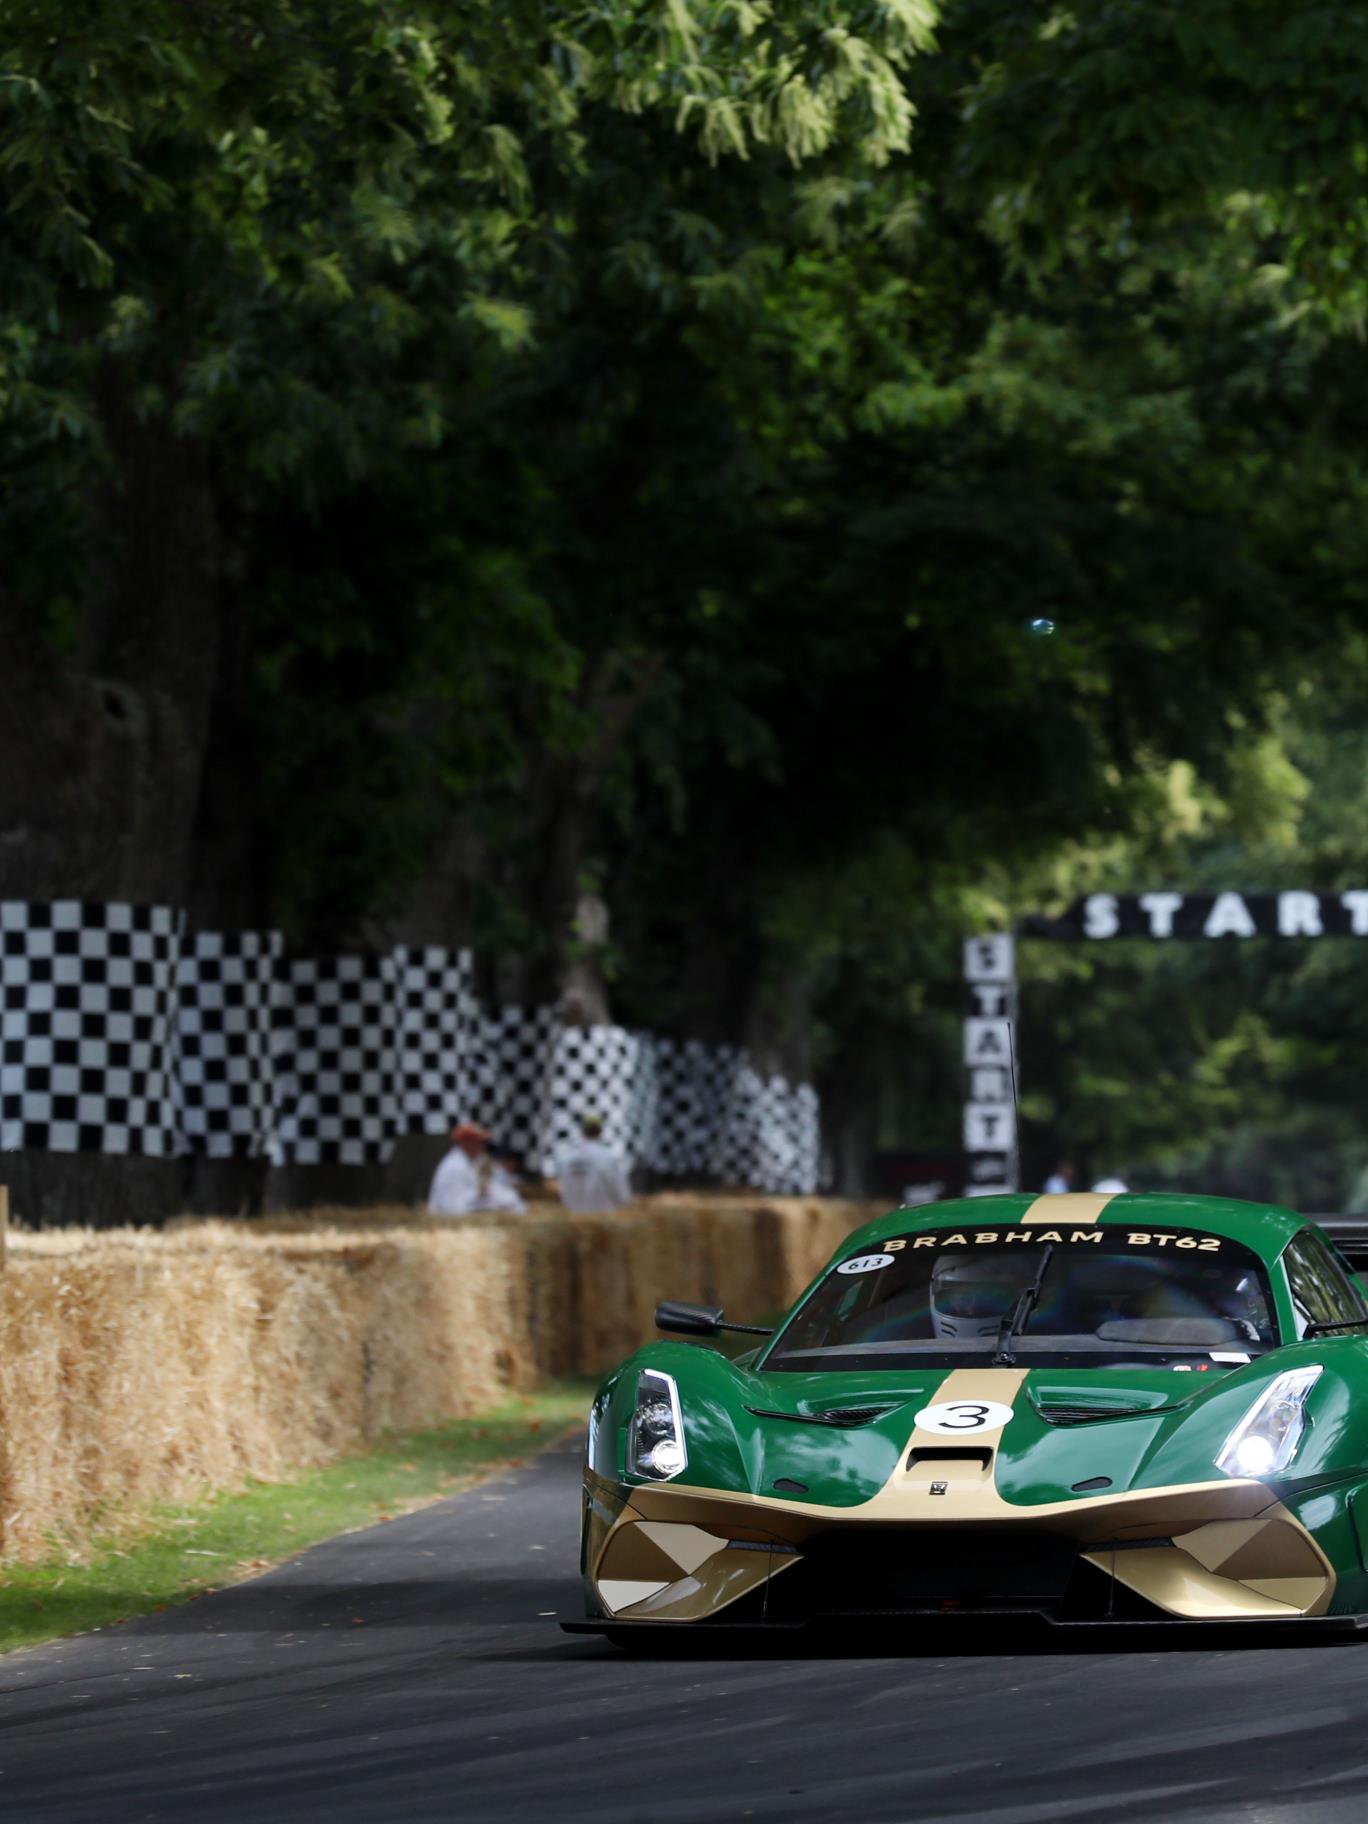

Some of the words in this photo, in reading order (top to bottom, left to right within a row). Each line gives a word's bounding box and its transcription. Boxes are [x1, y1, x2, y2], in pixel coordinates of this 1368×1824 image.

[883, 1231, 1104, 1252] BRABHAM
[1127, 1232, 1221, 1252] BT62
[848, 1257, 884, 1271] 613
[937, 1404, 990, 1429] 3
